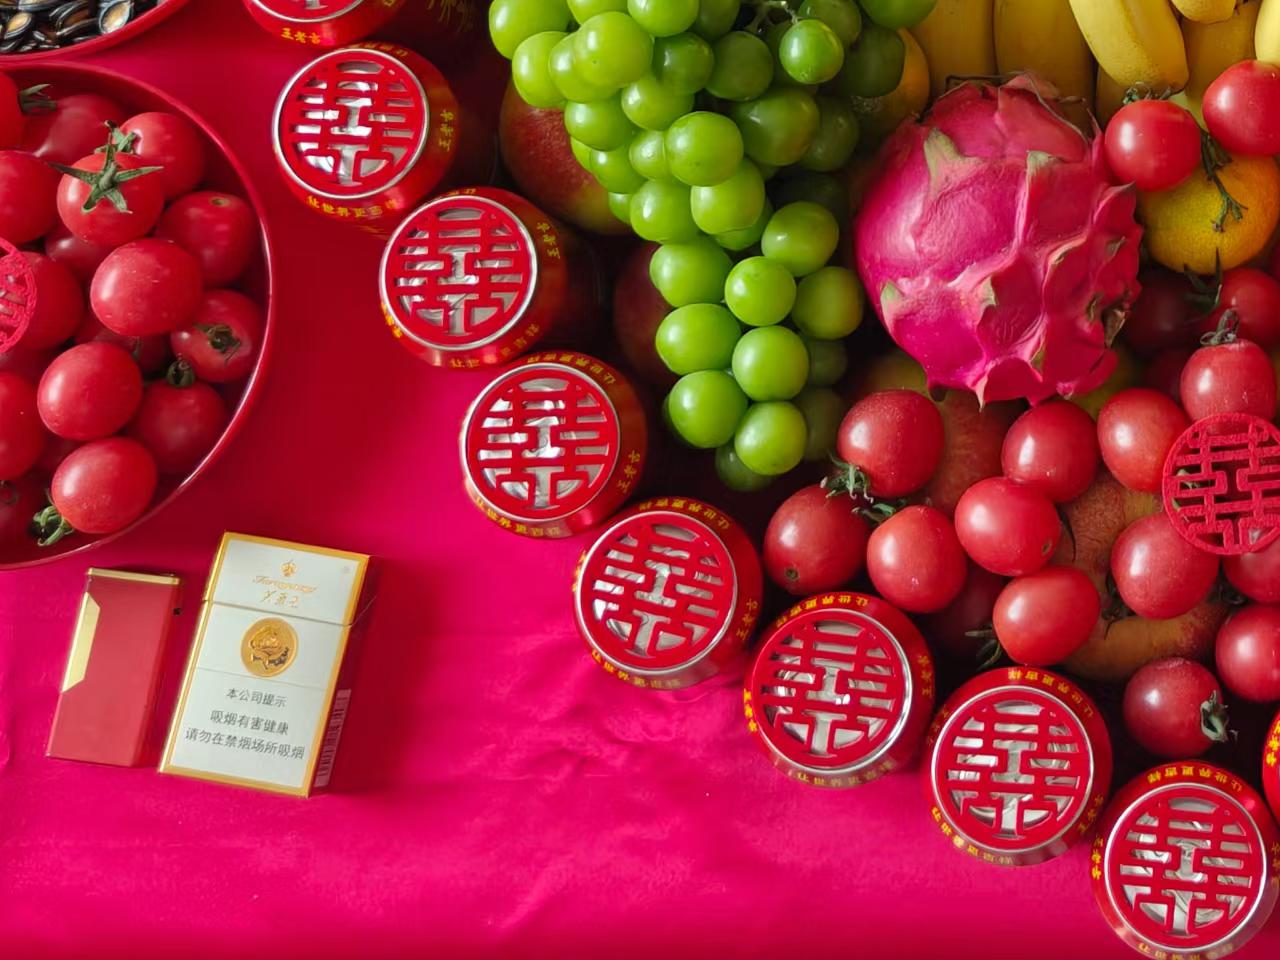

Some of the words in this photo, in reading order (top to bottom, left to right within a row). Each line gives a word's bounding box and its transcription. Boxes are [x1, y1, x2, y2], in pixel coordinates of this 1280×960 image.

[280, 26, 321, 44] 王老吉
[225, 688, 288, 709] 本公司提示
[209, 710, 289, 735] 吸烟有害健康
[185, 728, 306, 760] 请勿在禁烟场所吸烟
